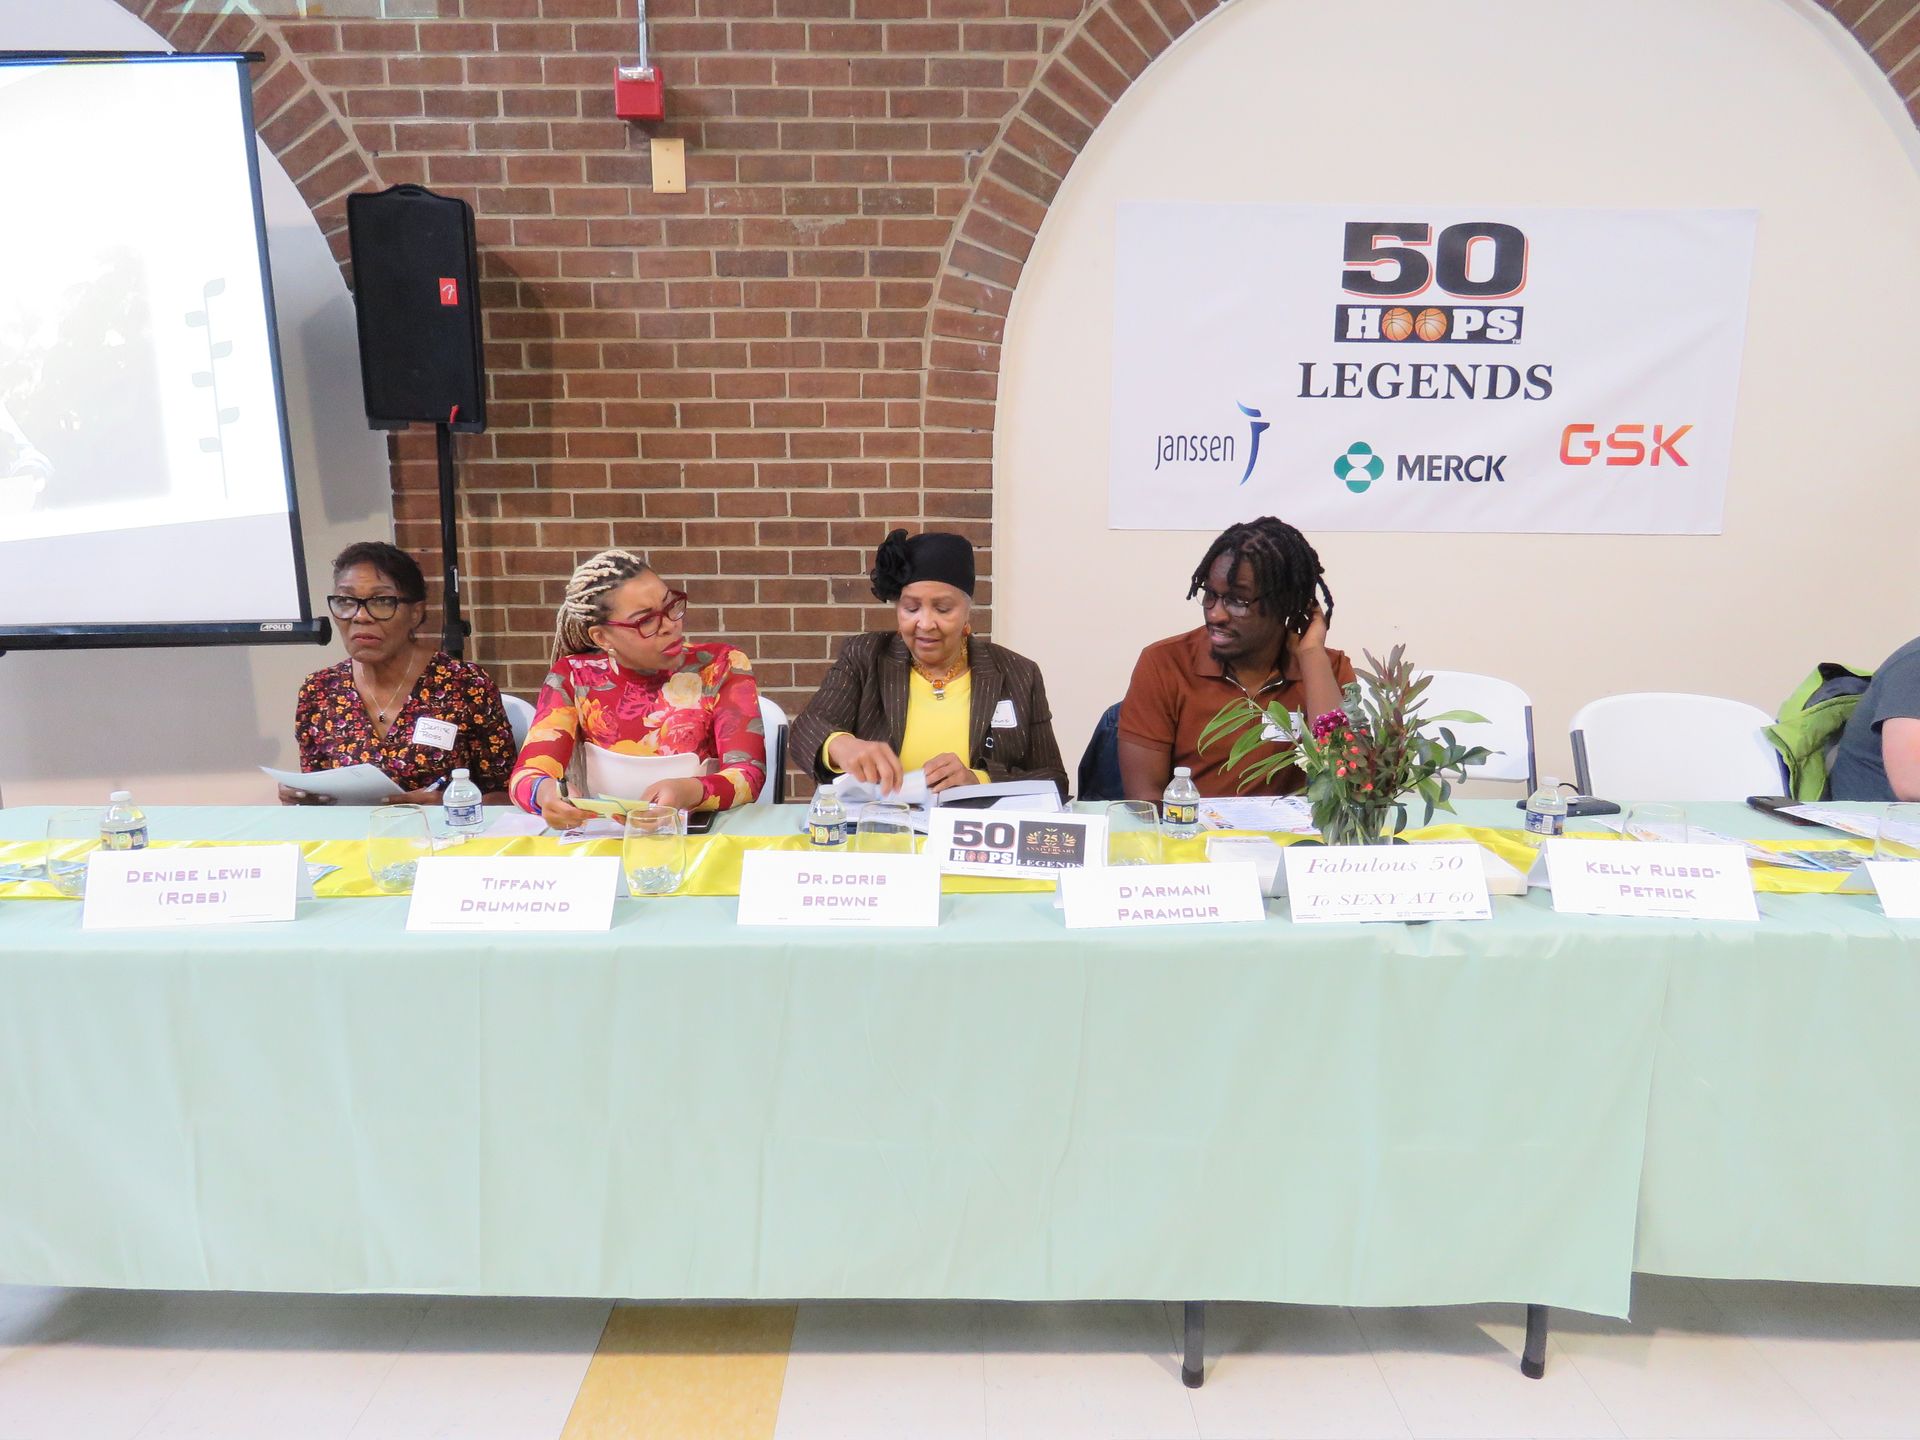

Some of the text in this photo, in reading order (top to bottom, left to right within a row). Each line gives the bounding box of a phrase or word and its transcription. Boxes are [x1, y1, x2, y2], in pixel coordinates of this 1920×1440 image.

[1341, 222, 1529, 300] 50
[1345, 306, 1518, 341] HOOPS
[1297, 362, 1553, 401] LEGENDS
[1559, 423, 1694, 466] GSK
[1396, 455, 1508, 482] MERCK
[952, 820, 1016, 850] 50
[1043, 834, 1058, 844] 25
[953, 849, 1013, 865] HOOPS
[1017, 858, 1084, 868] LEGENDS
[1306, 856, 1463, 874] Fabulous 50
[1586, 861, 1721, 878] KELLY RUSSO-
[126, 868, 262, 883] DENISE LEWIS
[482, 877, 557, 890] TIFFANY
[158, 890, 228, 905] (ROSS)
[1119, 885, 1211, 898] D'ARMANI
[1307, 891, 1475, 907] To SEXY AT 60
[1619, 885, 1697, 899] PETRICK
[460, 899, 571, 912] DRUMMOND
[803, 896, 878, 907] BROWNE
[1118, 907, 1220, 920] PARAMOUR
